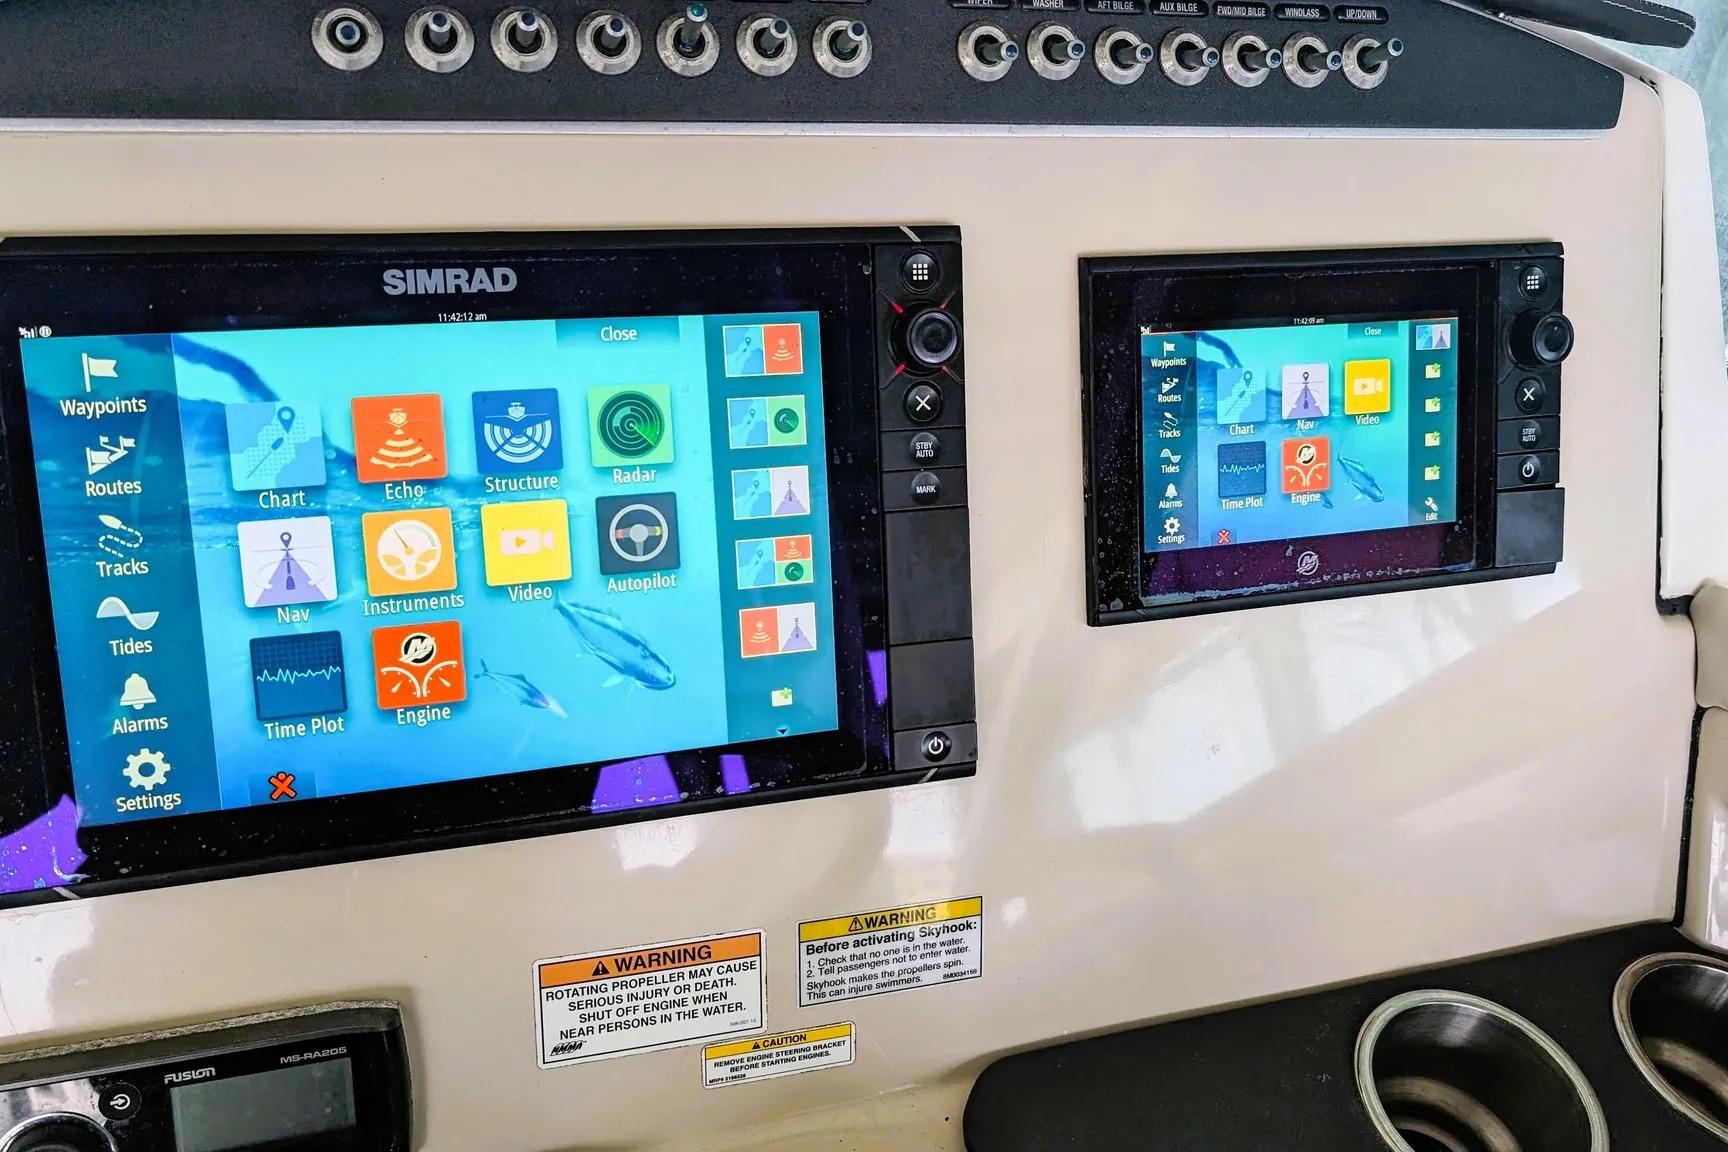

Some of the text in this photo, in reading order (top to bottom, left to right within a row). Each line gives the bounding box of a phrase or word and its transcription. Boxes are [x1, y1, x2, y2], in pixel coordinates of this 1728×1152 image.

[1032, 0, 1064, 8] WASHER
[1097, 0, 1134, 10] AFT BILGE
[1159, 3, 1198, 12] AUX BILGE
[1217, 6, 1266, 17] FWD/MID BILGE
[1285, 8, 1320, 18] WINDLASS
[1346, 9, 1377, 19] UP/DOWN
[382, 267, 518, 296] SIMRAD
[438, 312, 487, 322] 11:42:12 am
[600, 326, 637, 342] Close
[1364, 327, 1382, 336] Close
[1151, 357, 1187, 369] Waypoints
[59, 396, 147, 419] Waypoints
[1158, 394, 1182, 403] Routes
[1297, 419, 1315, 431] Nav
[1355, 415, 1380, 426] Video
[1159, 429, 1181, 438] Tracks
[1229, 424, 1254, 436] Chart
[915, 441, 933, 450] STBY
[916, 449, 934, 458] AUTO
[612, 467, 657, 485] Radar
[1161, 464, 1180, 473] Tides
[85, 478, 142, 498] Routes
[385, 482, 424, 500] Echo
[485, 474, 558, 494] Structure
[916, 485, 936, 494] MARK
[259, 490, 305, 510] Chart
[1159, 500, 1183, 509] Alarms
[1221, 497, 1264, 510] Time Plot
[1291, 492, 1321, 505] Engine
[1425, 513, 1439, 521] Edit
[1158, 533, 1185, 545] Settings
[96, 558, 149, 578] Tracks
[607, 573, 677, 594] Autopilot
[508, 585, 553, 602] Video
[362, 592, 465, 617] Instruments
[276, 606, 310, 624] Nav
[109, 638, 153, 656] Tides
[397, 705, 451, 727] Engine
[112, 716, 168, 735] Alarms
[264, 716, 345, 740] Time Plot
[116, 791, 182, 813] Settings
[864, 907, 937, 929] WARNING
[806, 920, 977, 956] Before activating Skyhook:
[614, 944, 712, 973] WARNING
[806, 945, 971, 978] 2. Tell passengers not to enter water.
[807, 936, 966, 969] 1. Check that no one is in the water.
[545, 960, 758, 1002] ROTATING PROPELLER MAY CAUSE
[806, 957, 964, 993] Skyhook makes the propellers spin.
[568, 977, 738, 1012] SERIOUS INJURY OR DEATH.
[806, 976, 923, 1001] This can injure swimmers.
[579, 991, 728, 1023] SHUT OFF ENGINE WHEN
[560, 1001, 746, 1040] NEAR PERSONS IN THE WATER.
[762, 1033, 807, 1048] CAUTION
[280, 1046, 347, 1064] MS-RA205
[713, 1040, 846, 1068] REMOVE ENGINE STEERING BRACKET
[729, 1050, 831, 1073] BEFORE STARTING ENGINES.
[164, 1067, 216, 1085] FUSION
